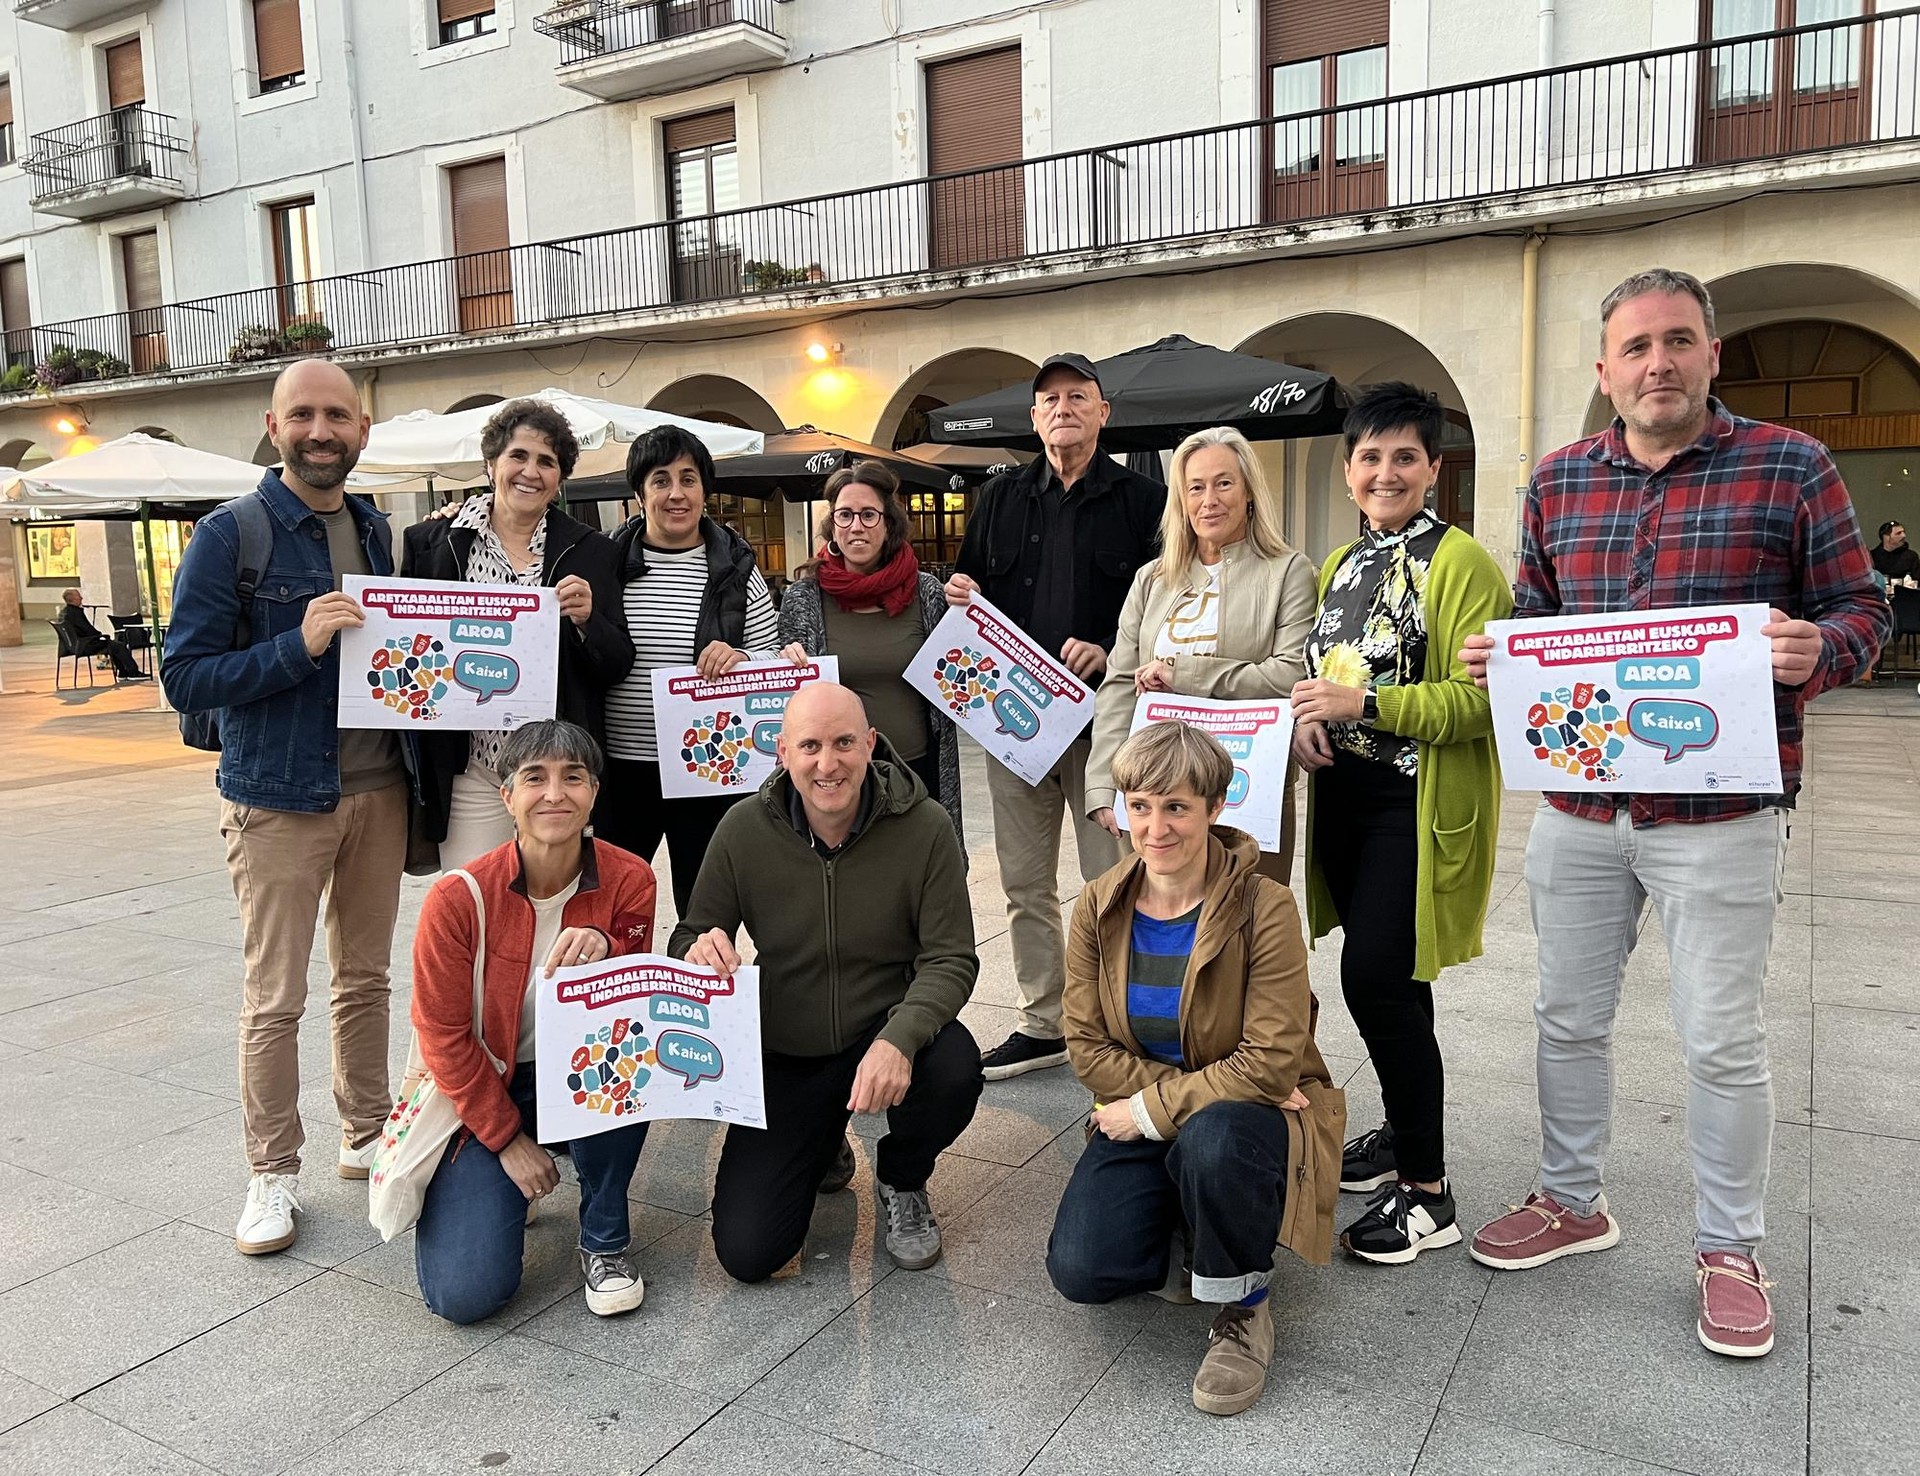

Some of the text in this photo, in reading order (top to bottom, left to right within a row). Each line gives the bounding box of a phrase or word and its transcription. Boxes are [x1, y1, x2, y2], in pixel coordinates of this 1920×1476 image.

[1249, 380, 1306, 413] 18/70
[804, 451, 835, 473] 18/70
[367, 593, 535, 607] ARETXABALETAN EUSKARA
[393, 604, 512, 616] INDARBERRITZEKO
[455, 624, 506, 640] AROA
[1513, 621, 1732, 651] ARETXABALETAN EUSKARA
[970, 608, 1081, 700] ARETXABALETAN EUSKARA
[982, 626, 1061, 693] INDARBERRITZEKO
[1543, 637, 1699, 661] INDARBERRITZEKO
[464, 661, 508, 680] Kaixo!
[765, 668, 816, 680] EUSKARA
[1624, 664, 1692, 682] AROA
[694, 679, 797, 697] INDARBERRITZEKO
[1012, 671, 1047, 704] AROA
[1001, 698, 1032, 731] Kaixo!
[1150, 707, 1276, 722] ARETXABALETAN EUSKARA
[1529, 709, 1543, 723] Hola
[1641, 711, 1703, 732] Kaixo!
[1217, 739, 1248, 753] ROA
[562, 969, 730, 998] ARETXABALETAN EUSKARA
[590, 981, 706, 1004] INDARBERRITZEKO
[656, 1000, 704, 1022] AROA
[668, 1041, 713, 1065] Kaixo!
